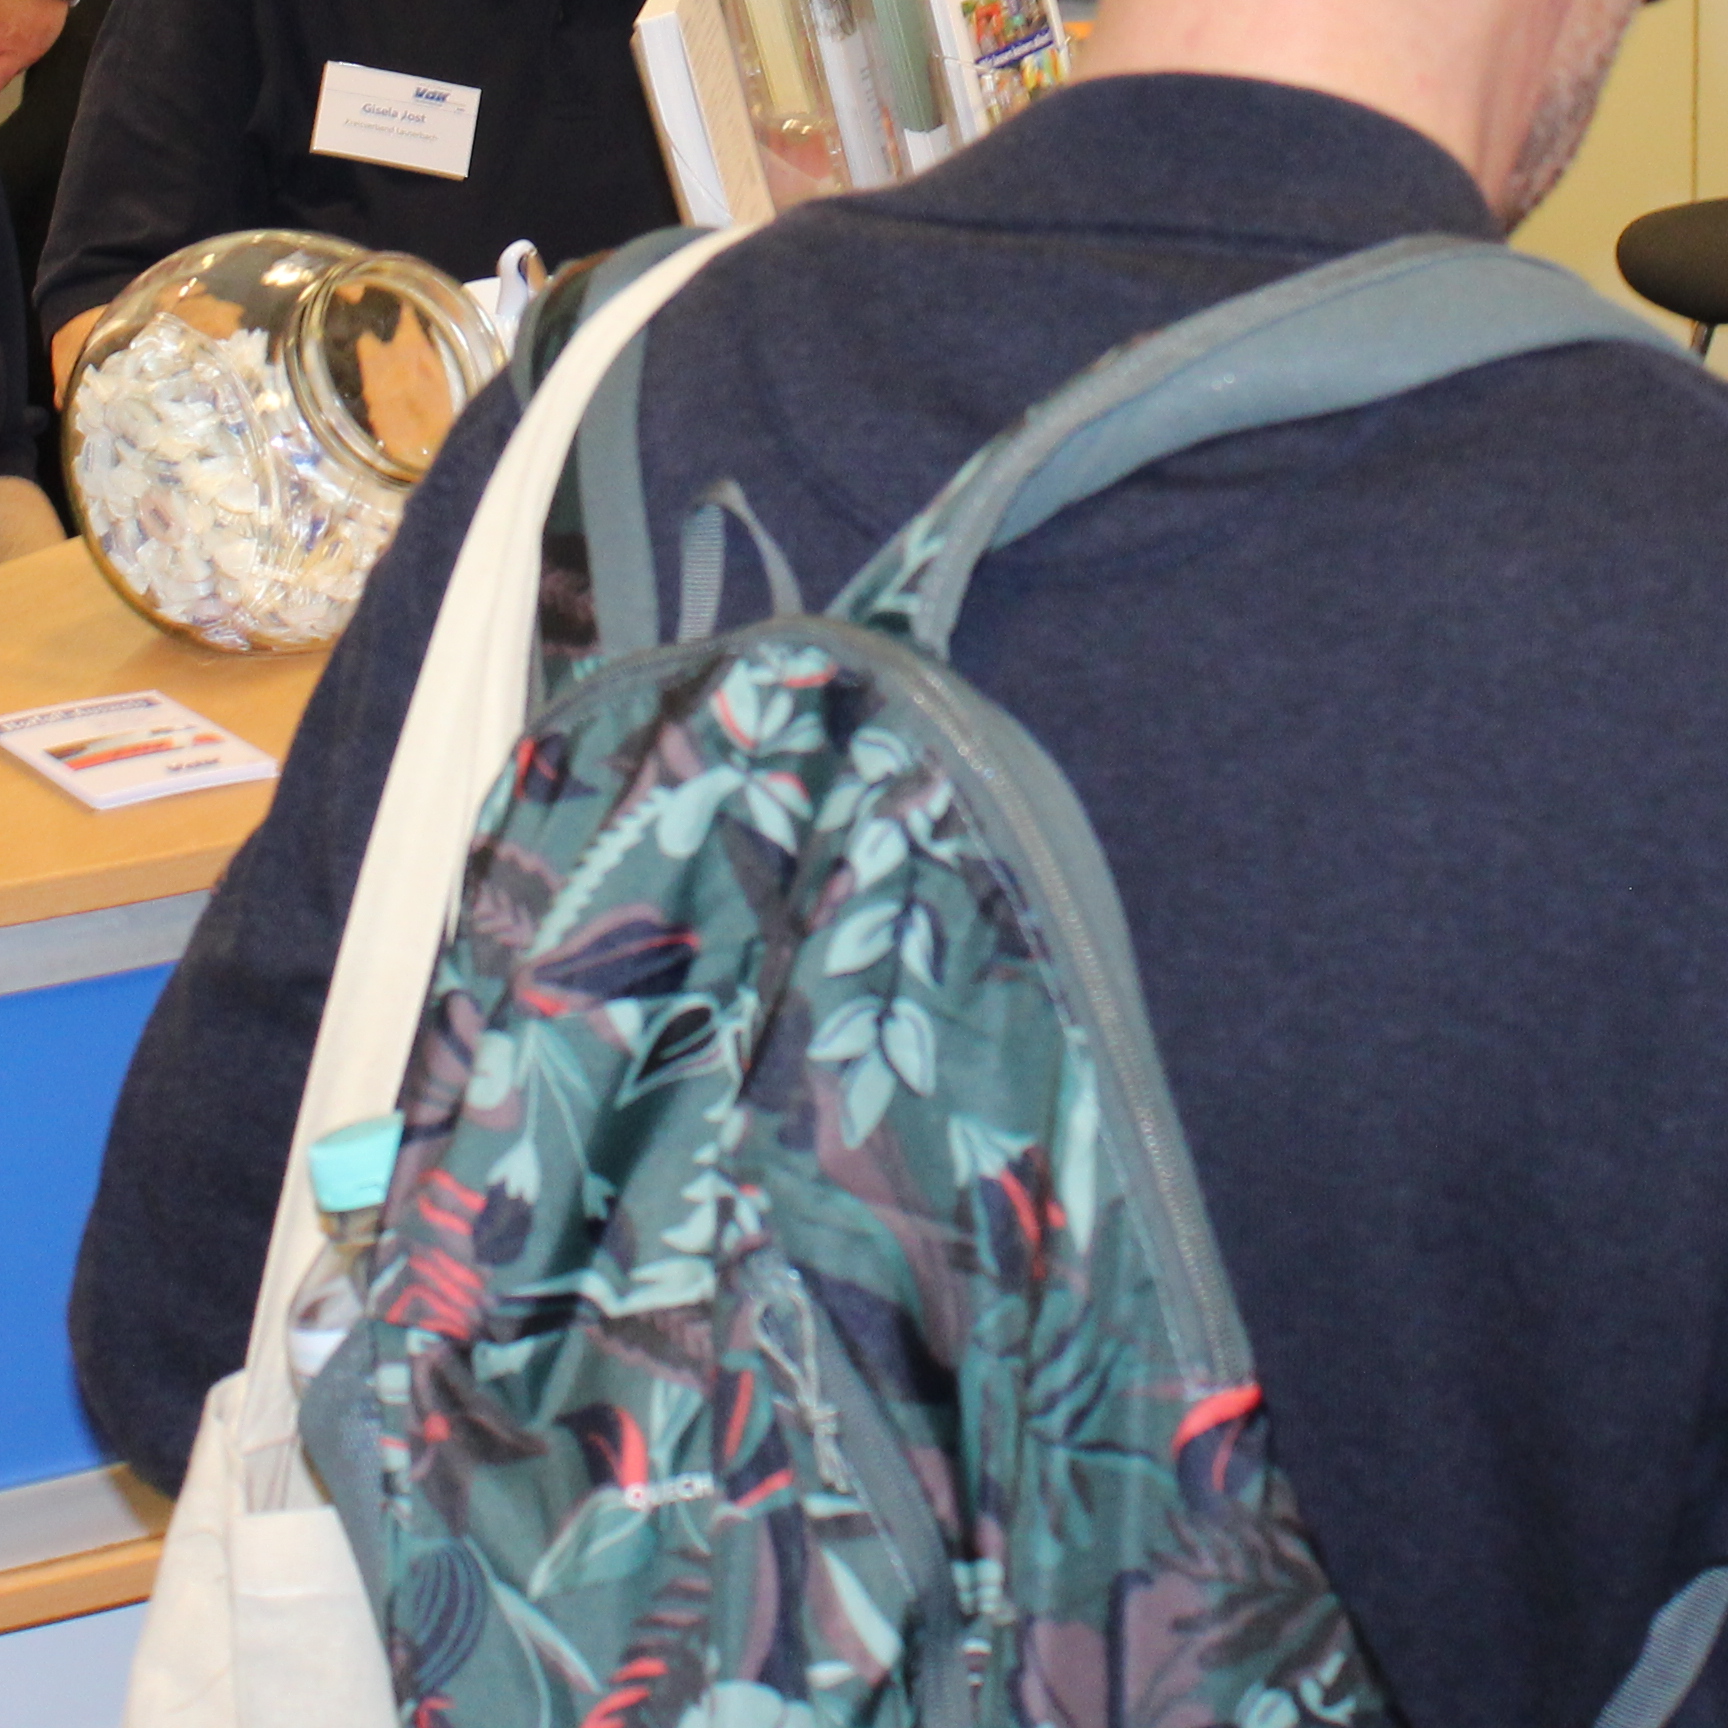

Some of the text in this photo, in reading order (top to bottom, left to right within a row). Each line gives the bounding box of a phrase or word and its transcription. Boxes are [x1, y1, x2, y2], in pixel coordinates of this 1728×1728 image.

[413, 86, 450, 103] VdK
[362, 102, 426, 124] Gisela Jost
